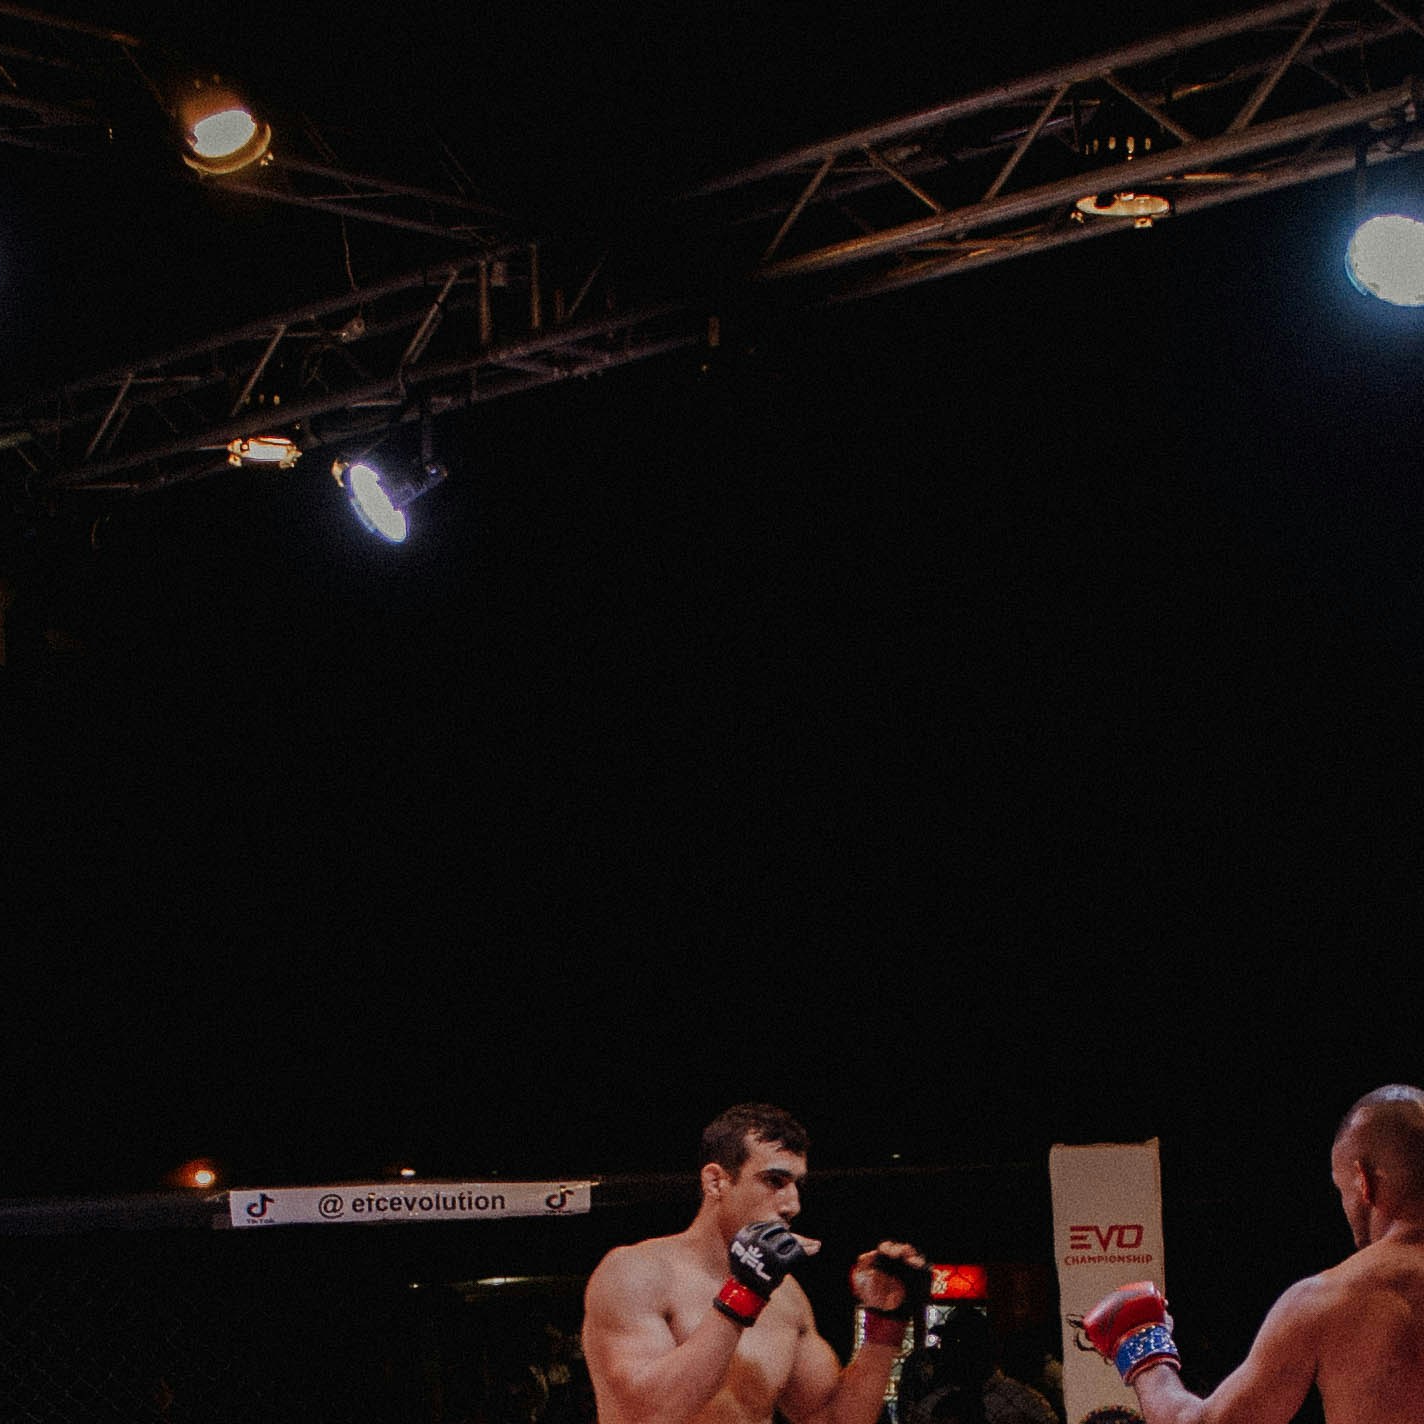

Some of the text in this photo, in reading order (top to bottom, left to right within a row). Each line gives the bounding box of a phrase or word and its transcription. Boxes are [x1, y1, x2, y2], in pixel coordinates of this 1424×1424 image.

[352, 1191, 506, 1213] efcevolution
[1070, 1225, 1144, 1251] EVO
[1065, 1254, 1153, 1266] CHAMPIONSHIP
